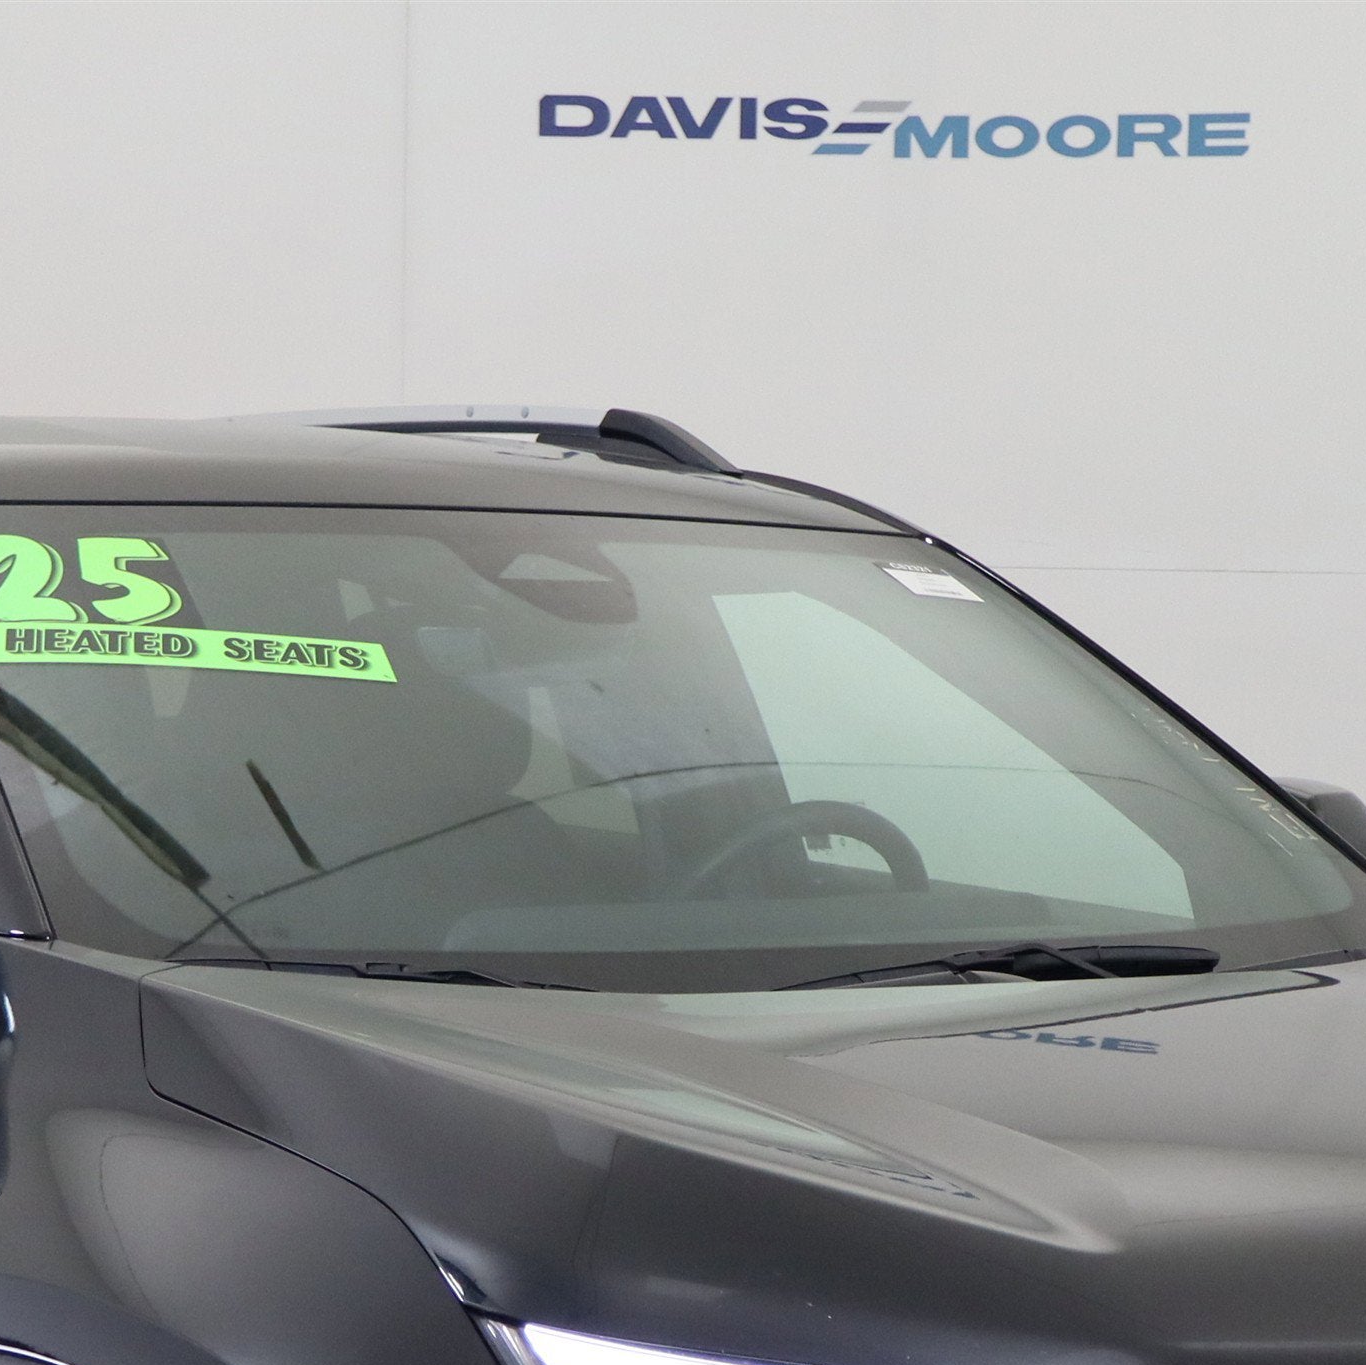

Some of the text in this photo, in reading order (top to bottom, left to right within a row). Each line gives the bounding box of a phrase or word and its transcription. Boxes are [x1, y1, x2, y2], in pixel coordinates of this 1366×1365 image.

[538, 94, 1252, 159] DAVIS MOORE
[5, 628, 371, 670] HEATED SEATS
